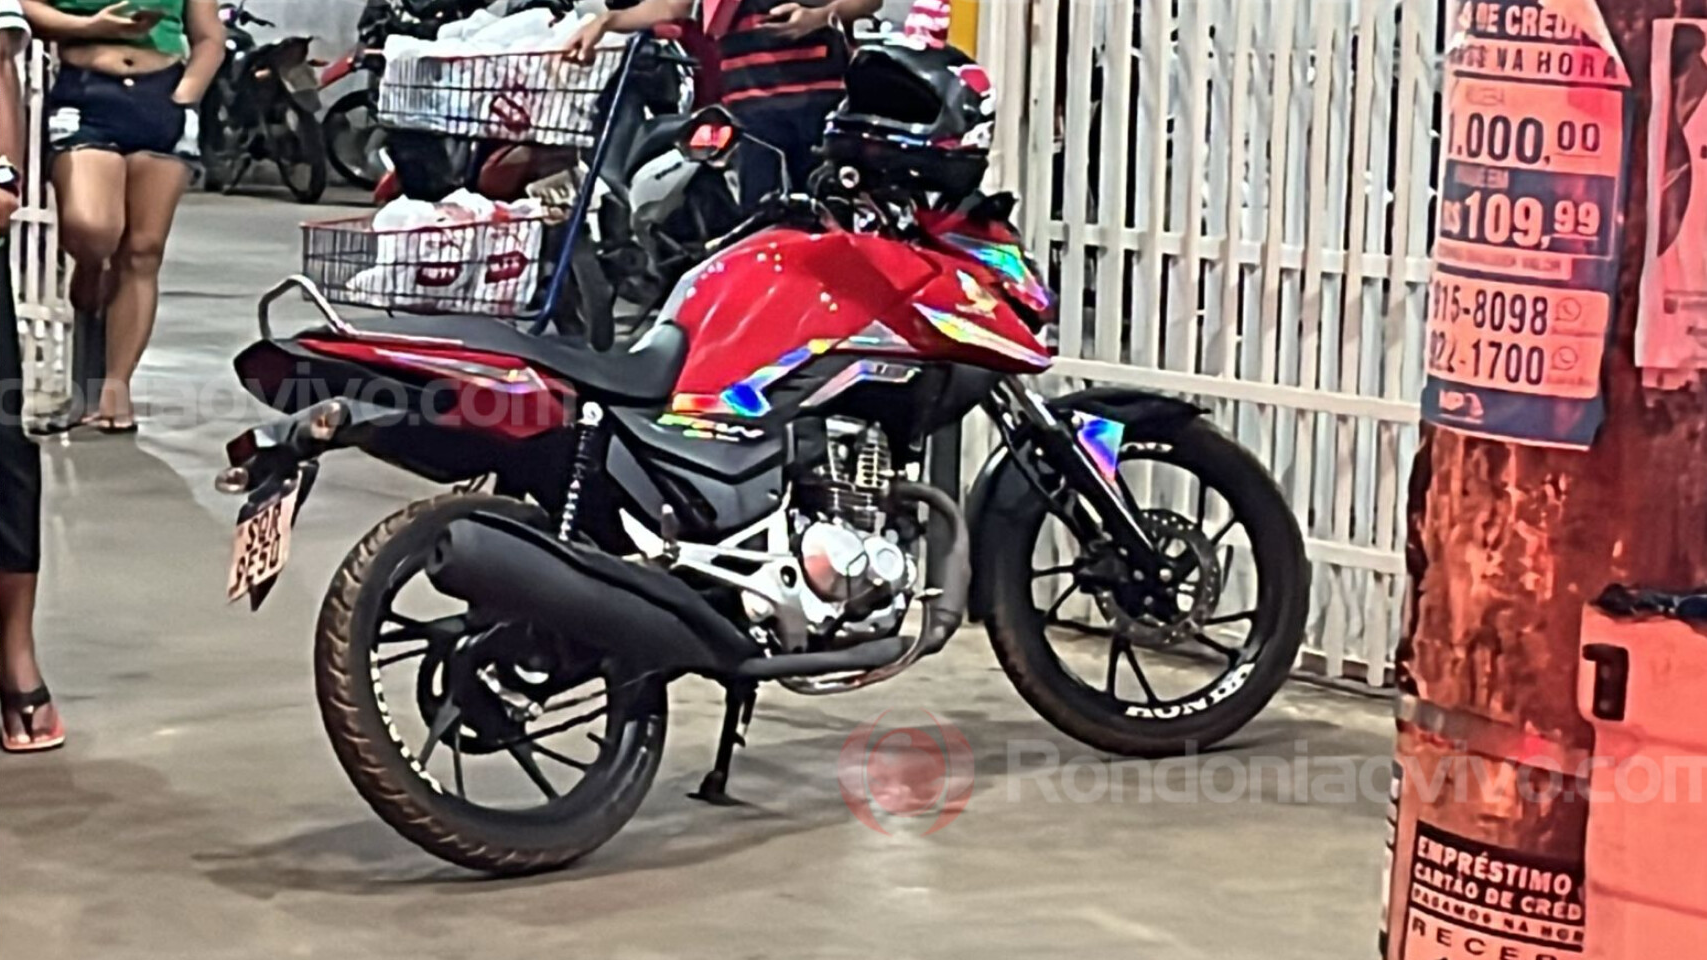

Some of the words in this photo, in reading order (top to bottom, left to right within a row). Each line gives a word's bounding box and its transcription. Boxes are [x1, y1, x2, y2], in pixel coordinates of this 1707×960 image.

[1537, 50, 1618, 79] HORA
[1417, 835, 1572, 896] EMPRÉSTIMO
[1413, 862, 1479, 900] CARTÃO
[1484, 887, 1515, 909] DE
[1503, 917, 1529, 933] NA
